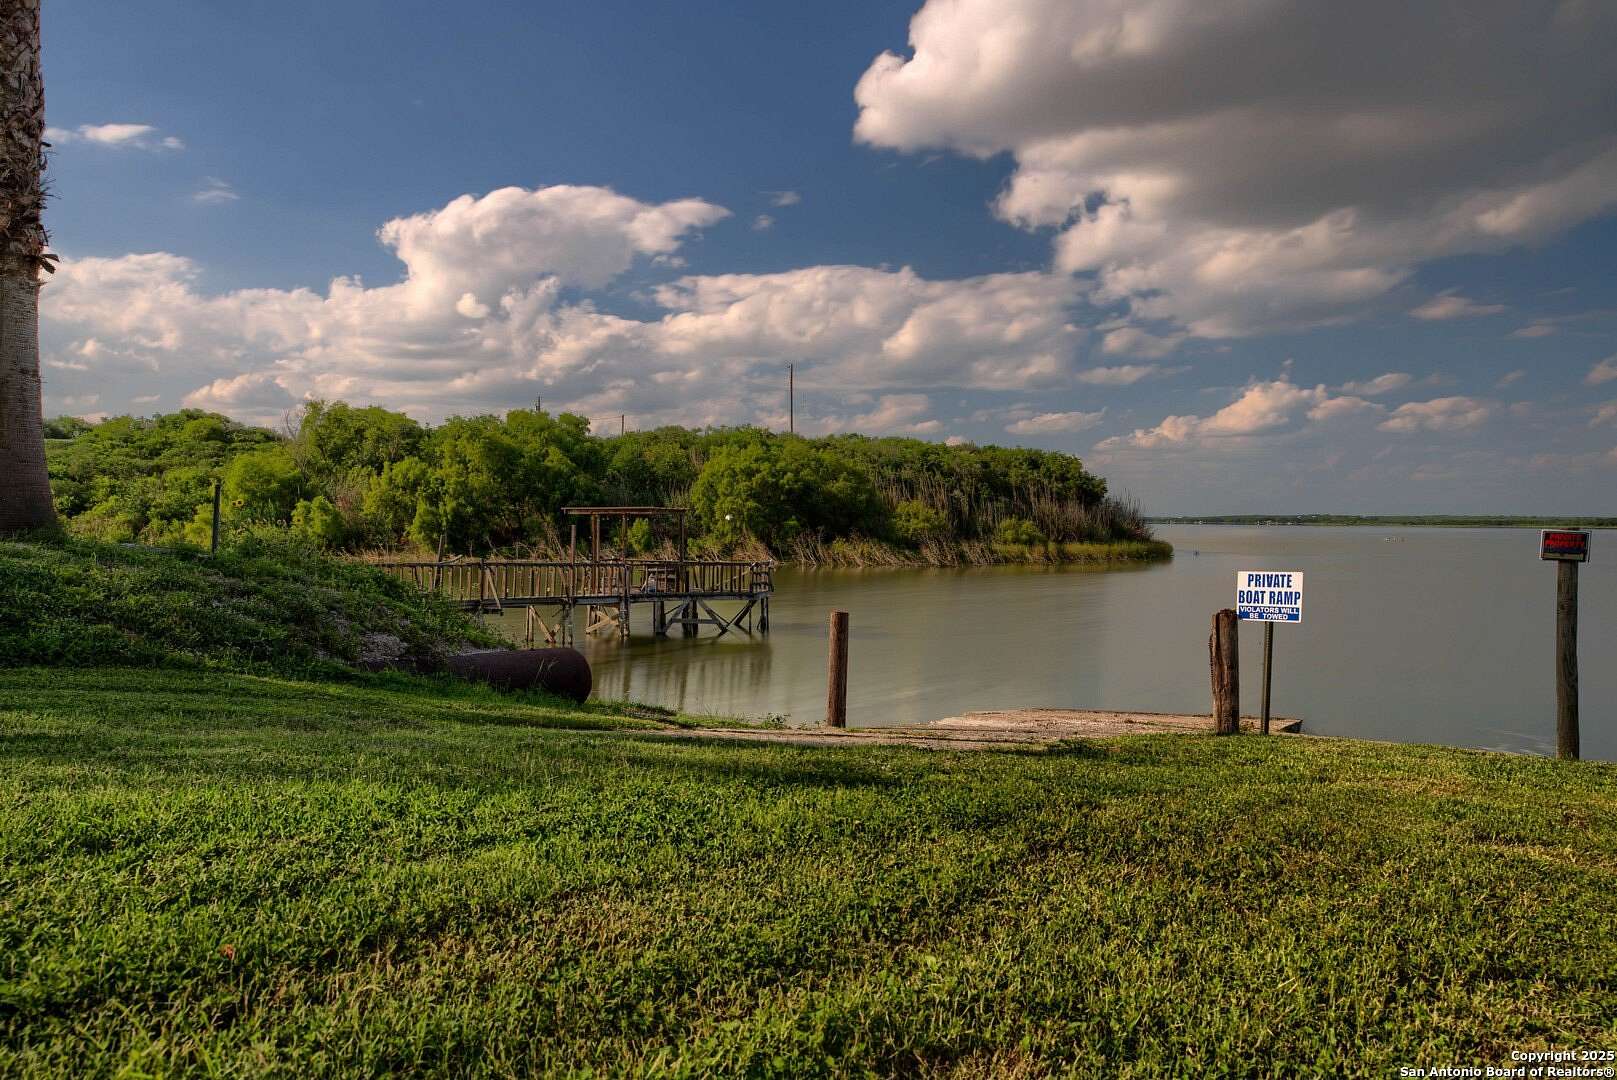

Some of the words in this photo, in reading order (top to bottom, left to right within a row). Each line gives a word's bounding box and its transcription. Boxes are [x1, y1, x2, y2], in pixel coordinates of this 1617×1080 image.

[1248, 574, 1292, 587] PRIVATE
[1238, 590, 1266, 604] BOAT
[1269, 591, 1301, 605] RAMP
